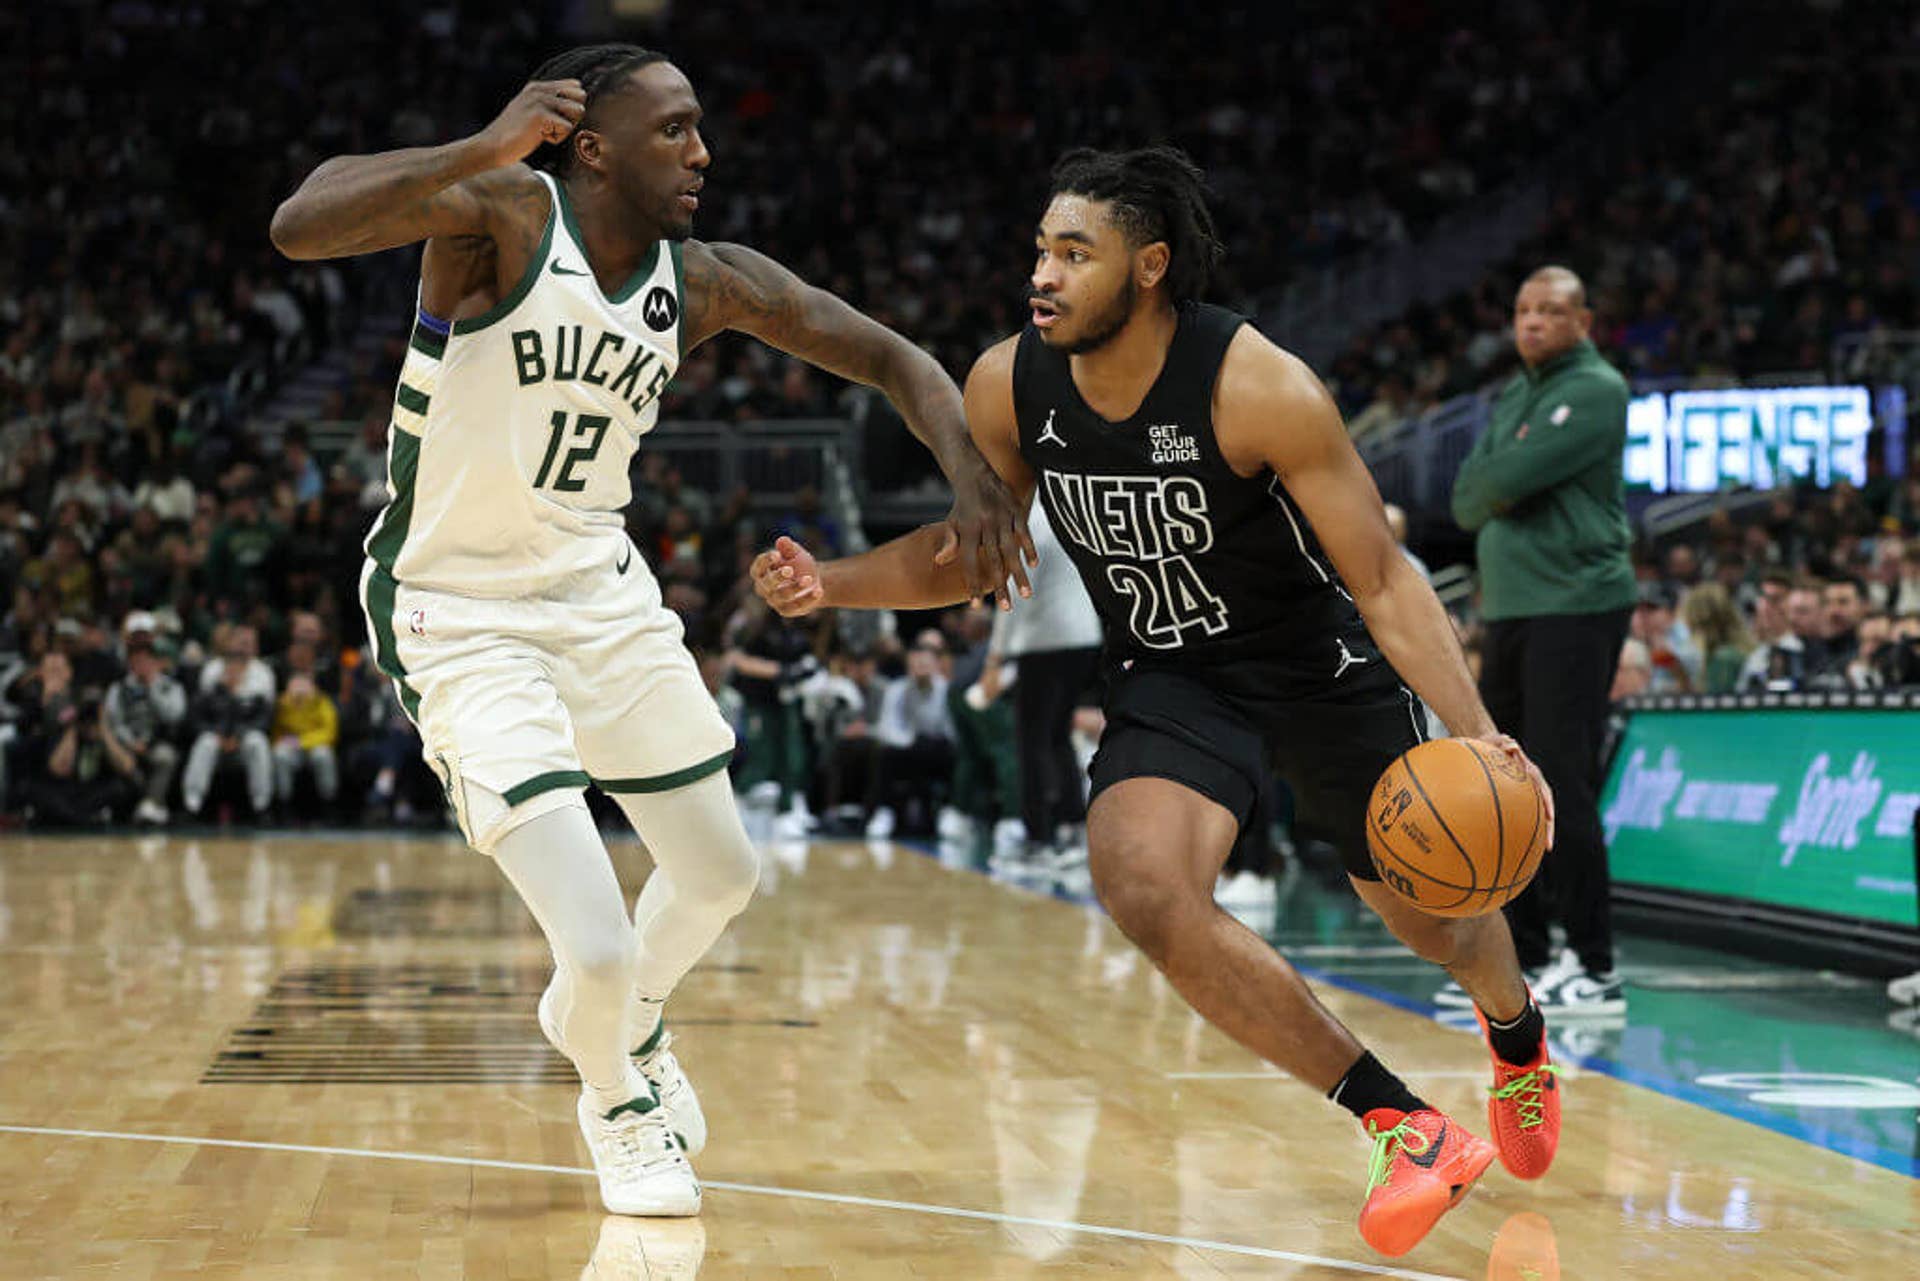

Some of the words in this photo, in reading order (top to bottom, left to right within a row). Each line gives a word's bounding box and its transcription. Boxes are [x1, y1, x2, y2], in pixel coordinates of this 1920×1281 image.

[511, 325, 669, 416] BUCKS
[532, 410, 612, 492] 12
[1149, 425, 1178, 438] GET
[1151, 436, 1196, 450] YOUR
[1152, 448, 1201, 464] GUIDE
[1043, 469, 1214, 562] NETS
[1106, 554, 1230, 650] 24
[1778, 750, 1882, 868] Sprite
